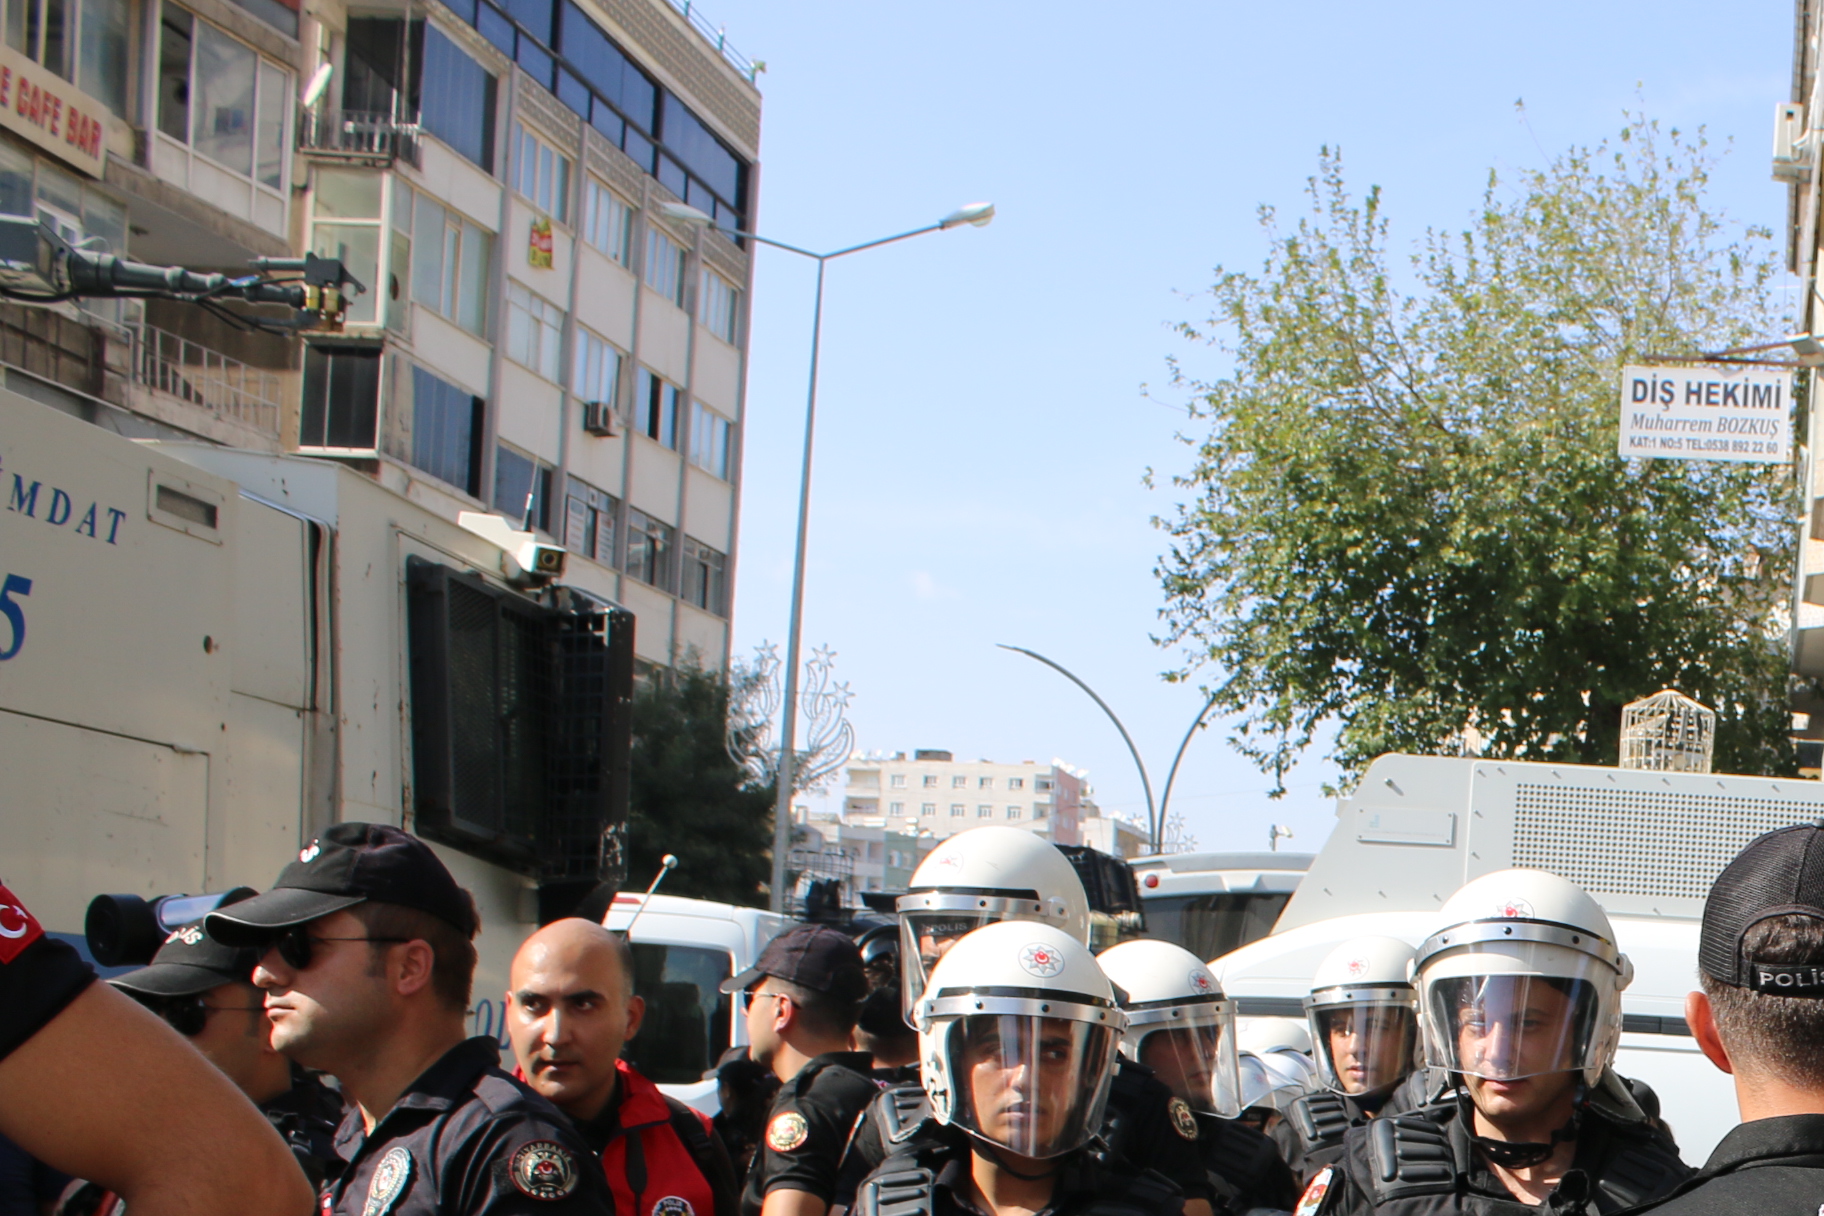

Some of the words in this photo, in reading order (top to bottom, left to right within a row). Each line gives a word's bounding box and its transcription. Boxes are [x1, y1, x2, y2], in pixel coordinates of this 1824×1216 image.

[66, 104, 102, 161] BAR
[1631, 373, 1676, 411] DİŞ
[1684, 377, 1782, 410] HEKİMİ
[1630, 413, 1713, 433] Muharrem
[1716, 416, 1781, 439] BOZKUŞ
[0, 456, 127, 546] MDAT
